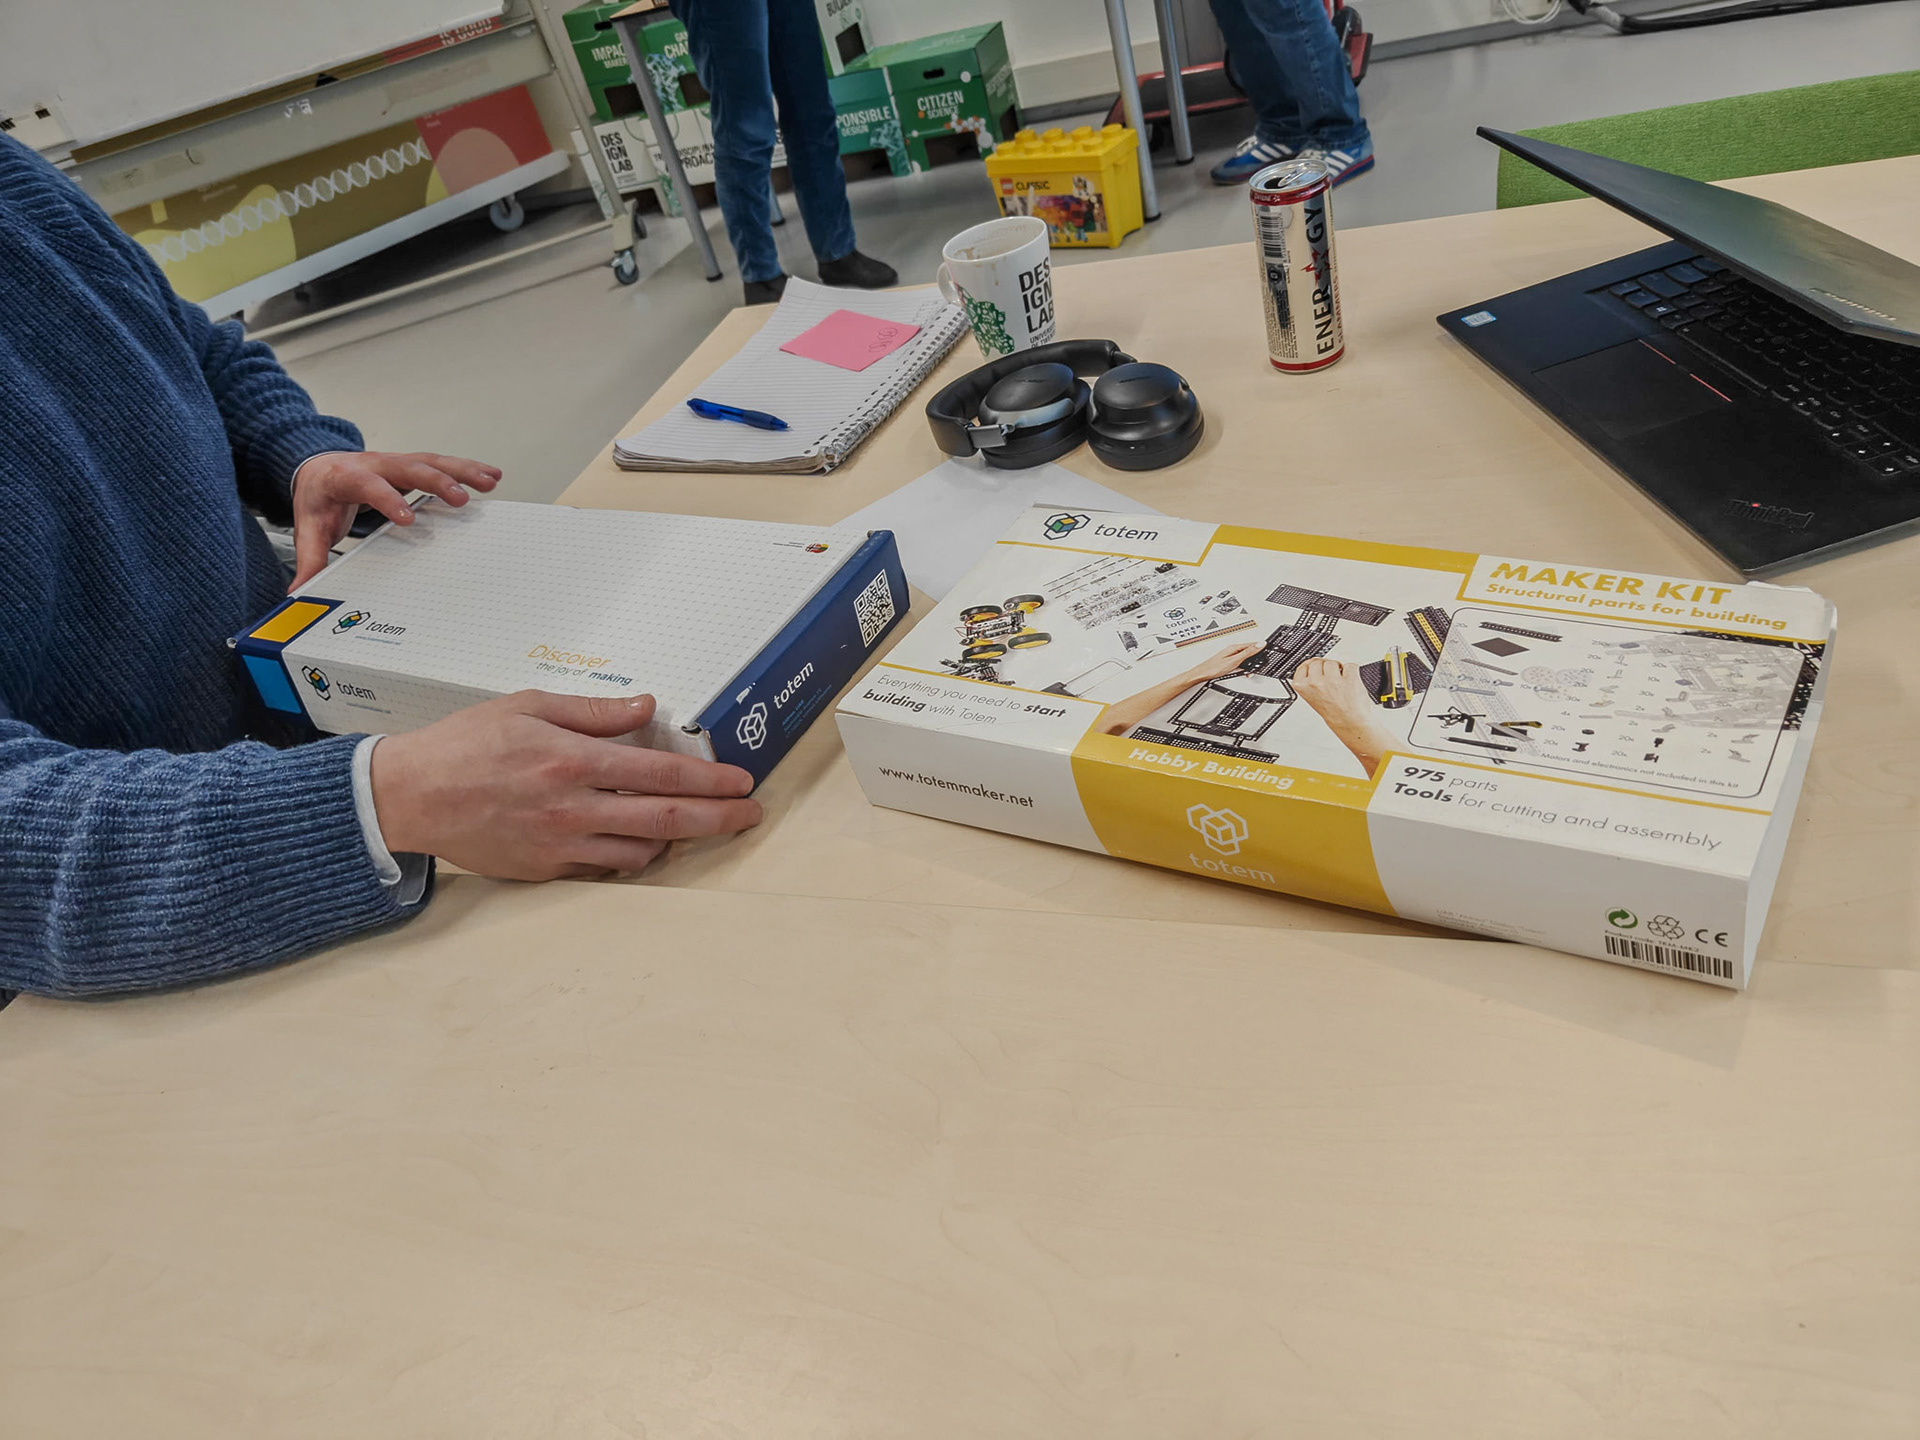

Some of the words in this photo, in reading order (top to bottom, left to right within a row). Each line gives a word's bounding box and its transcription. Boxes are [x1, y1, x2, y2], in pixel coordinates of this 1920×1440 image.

[835, 106, 892, 129] PONSIBLE
[916, 90, 964, 112] CITIZEN
[600, 132, 624, 148] DES
[604, 145, 629, 162] IGN
[610, 158, 634, 174] LAB
[1018, 257, 1050, 293] DES
[1026, 299, 1055, 334] LAB
[1094, 523, 1159, 541] totem
[1489, 562, 1645, 596] MAKER
[1655, 581, 1732, 605] KIT
[1486, 583, 1585, 604] Structural
[1588, 597, 1646, 613] parts
[1650, 602, 1686, 616] for
[1690, 606, 1787, 631] building
[365, 621, 406, 636] totem
[527, 644, 612, 669] Discover
[536, 661, 556, 672] the
[553, 664, 573, 676] joy
[572, 668, 589, 676] of
[588, 671, 633, 686] making
[773, 661, 815, 710] totem
[335, 680, 377, 701] totem
[863, 688, 928, 713] building
[929, 703, 956, 718] with
[957, 707, 998, 725] Totem
[877, 674, 941, 697] Everything
[943, 688, 967, 702] you
[970, 693, 1007, 709] need
[1007, 700, 1021, 711] to
[1023, 703, 1067, 718] start
[1128, 748, 1200, 773] Hobby
[1202, 761, 1295, 791] Building
[1403, 766, 1446, 783] 975
[1448, 773, 1499, 793] parts
[1540, 752, 1571, 763] Motors
[1572, 757, 1590, 765] and
[1591, 760, 1639, 774] electronics
[1656, 770, 1697, 783] included
[1709, 779, 1726, 788] this
[879, 765, 1034, 808] www.totemmaker.net
[1393, 782, 1454, 803] Tools
[1457, 793, 1487, 809] for
[1490, 801, 1559, 825] cutting
[1563, 813, 1609, 830] and
[1613, 822, 1723, 852] assembly
[1188, 852, 1277, 885] totem
